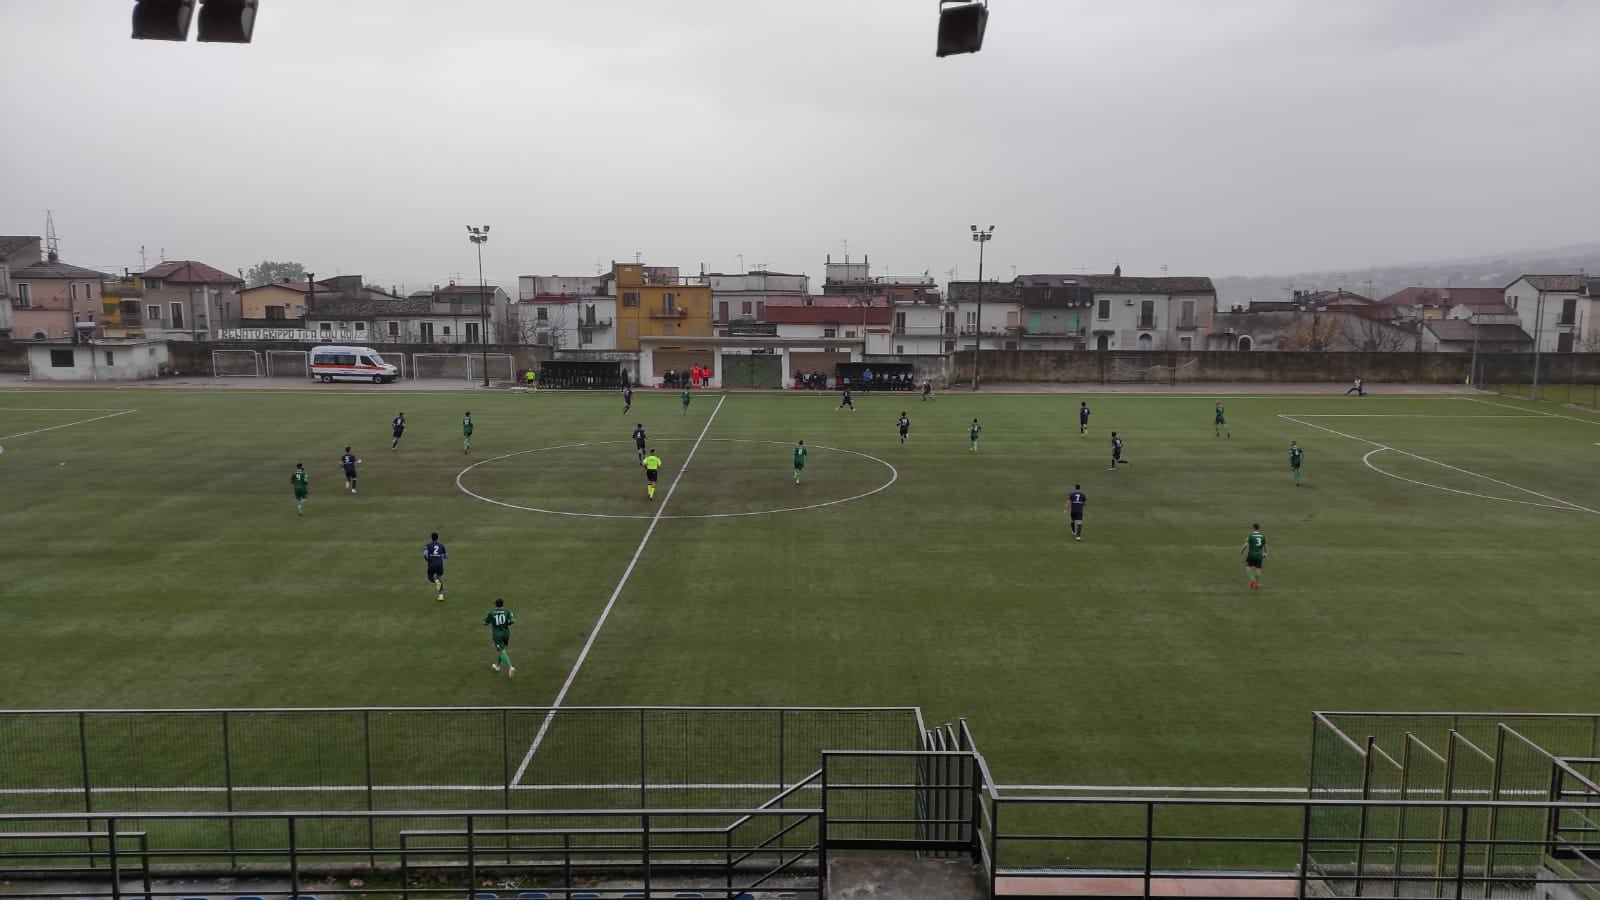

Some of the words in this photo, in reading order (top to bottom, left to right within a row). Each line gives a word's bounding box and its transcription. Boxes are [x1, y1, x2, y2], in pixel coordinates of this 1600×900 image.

[223, 328, 261, 339] RENATO
[263, 328, 295, 339] GRIPPO
[1075, 494, 1081, 502] 7
[1255, 537, 1262, 546] 3
[433, 545, 439, 554] 2
[494, 614, 506, 626] 10
